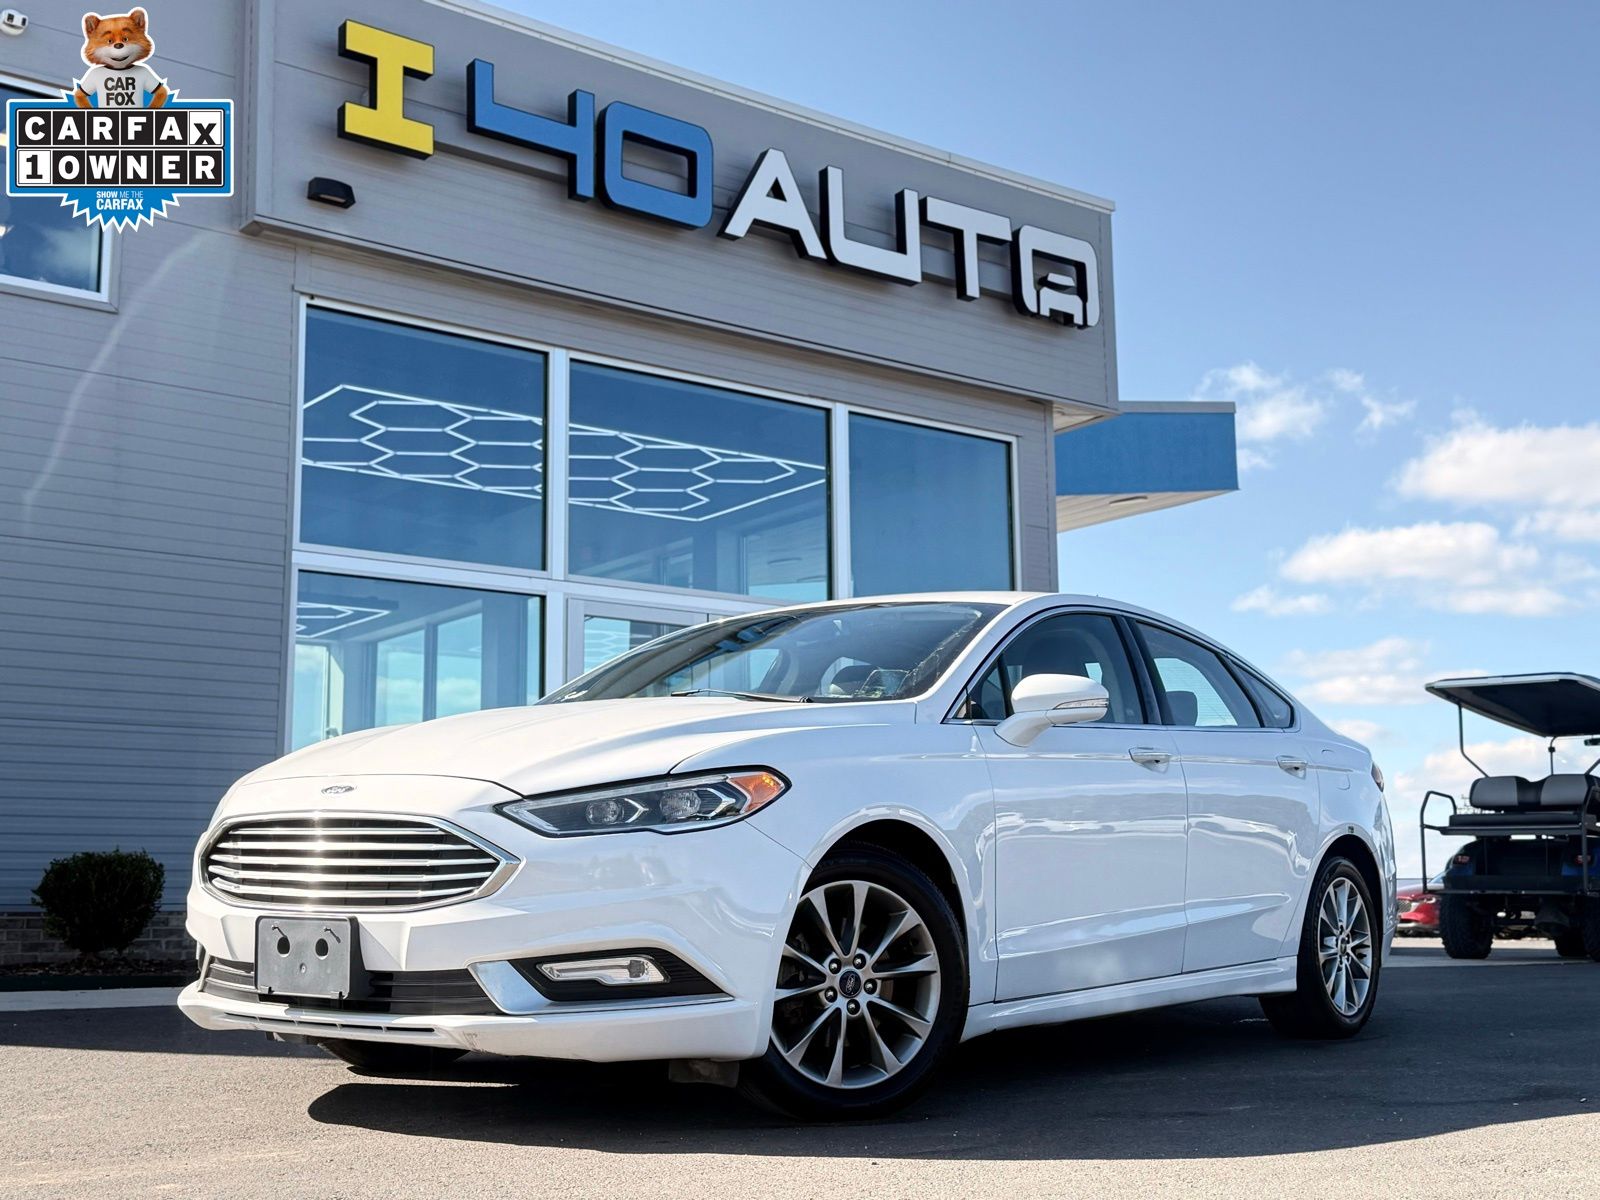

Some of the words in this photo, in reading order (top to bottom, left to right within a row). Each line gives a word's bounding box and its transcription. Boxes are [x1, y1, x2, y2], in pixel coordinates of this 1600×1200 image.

[339, 19, 434, 158] I
[467, 58, 714, 229] 40
[717, 147, 1101, 328] AUTO
